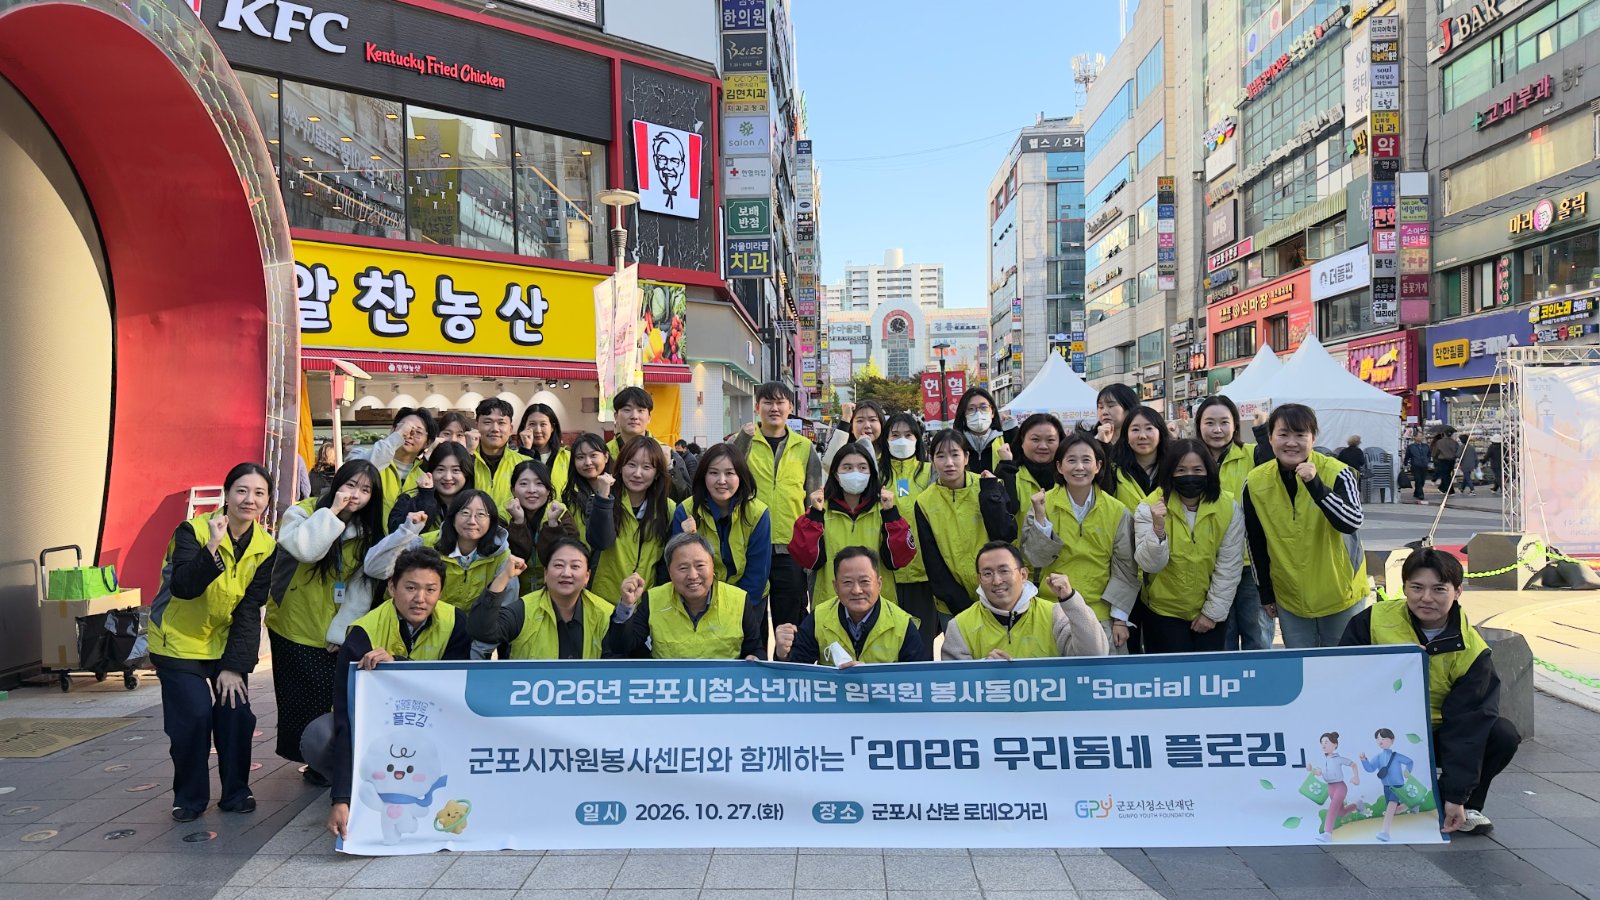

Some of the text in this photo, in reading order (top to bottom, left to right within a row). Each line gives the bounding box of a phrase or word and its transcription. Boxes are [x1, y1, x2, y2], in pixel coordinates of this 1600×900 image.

[218, 0, 349, 54] KFC
[723, 8, 765, 28] 한의원
[1439, 0, 1502, 54] J BAR
[366, 41, 506, 89] Kentucky Fried Chicken
[726, 89, 767, 100] 김현치과
[1486, 74, 1553, 122] 고피부과
[1374, 123, 1396, 133] 내과
[729, 138, 755, 147] salon
[1378, 137, 1395, 157] 약
[738, 206, 759, 217] 보배
[738, 218, 760, 229] 반점
[729, 242, 769, 251] 서울미라클
[1403, 235, 1427, 245] 한의원
[730, 252, 770, 273] 치과
[296, 261, 549, 346] 알찬농산
[1241, 292, 1270, 317] 신마장
[1541, 301, 1572, 319] 코인노래
[924, 377, 962, 398] 헌 혈
[509, 670, 1256, 706] 2026년 군포시청소년재단 임직원 봉사동아리 "Social Up"
[393, 711, 429, 729] 플로깅
[469, 745, 733, 775] 군포시자원봉사센터와
[993, 735, 1152, 770] 우리동네
[635, 802, 689, 821] 2026.
[695, 802, 722, 820] 10.
[726, 801, 785, 821] 27.(화)
[872, 802, 921, 820] 군포시
[925, 802, 960, 820] 산본
[964, 802, 1048, 821] 로데오거리
[1116, 799, 1195, 812] 군포시청소년재단
